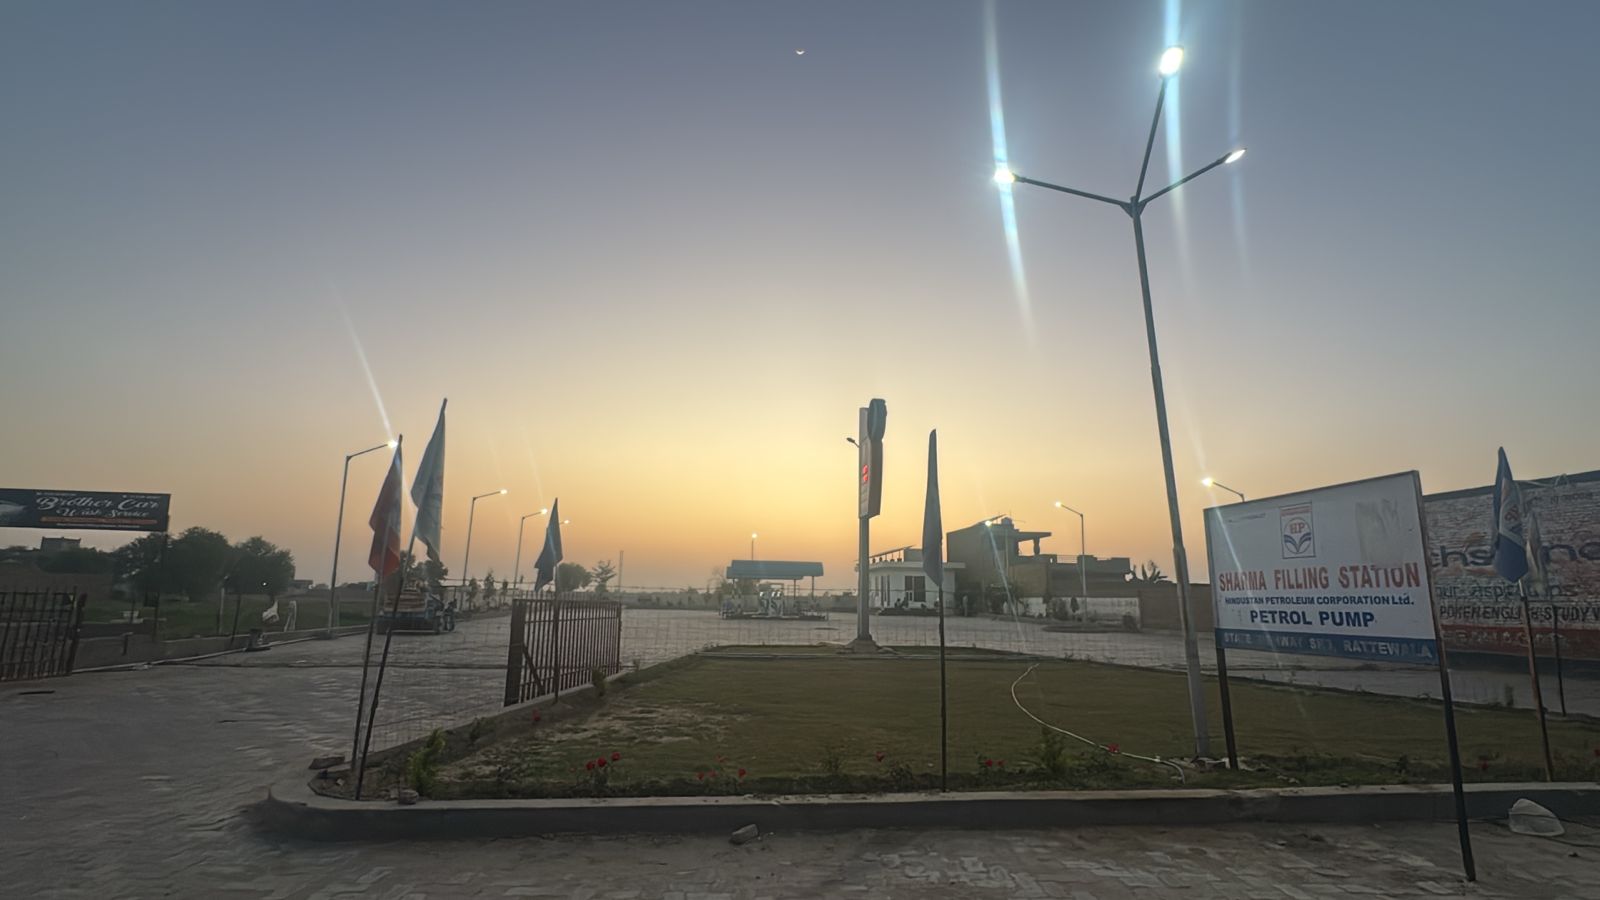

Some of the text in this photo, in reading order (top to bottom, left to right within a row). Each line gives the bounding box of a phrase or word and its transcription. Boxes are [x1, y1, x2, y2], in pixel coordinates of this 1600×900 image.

[36, 496, 114, 510] Brother
[118, 499, 160, 511] Car
[107, 509, 150, 518] Service
[1289, 522, 1306, 535] HP
[1218, 562, 1421, 592] SHARMA FILLING STATION
[1224, 593, 1415, 605] HINDUSTAN PETROLEUM CORPORATION Ltd.
[1250, 609, 1375, 627] PETROL PUMP
